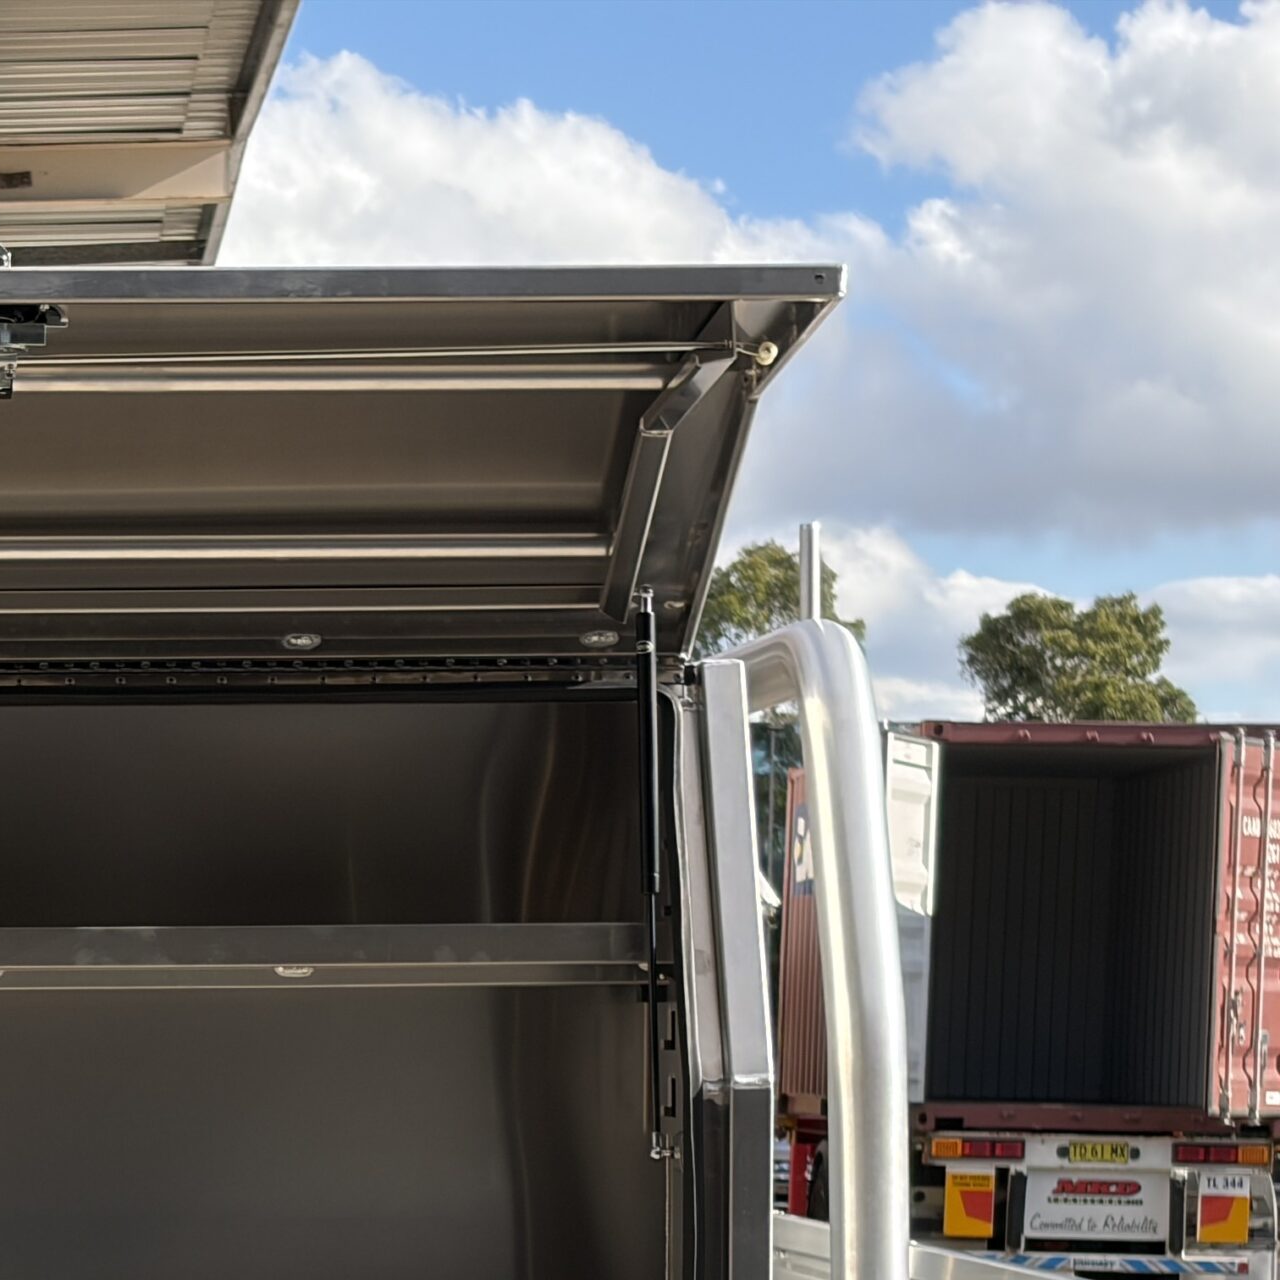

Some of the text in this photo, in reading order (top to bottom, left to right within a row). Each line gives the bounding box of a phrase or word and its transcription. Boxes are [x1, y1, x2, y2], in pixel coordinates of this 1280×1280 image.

[1029, 1213, 1159, 1235] Committed to Reliability
